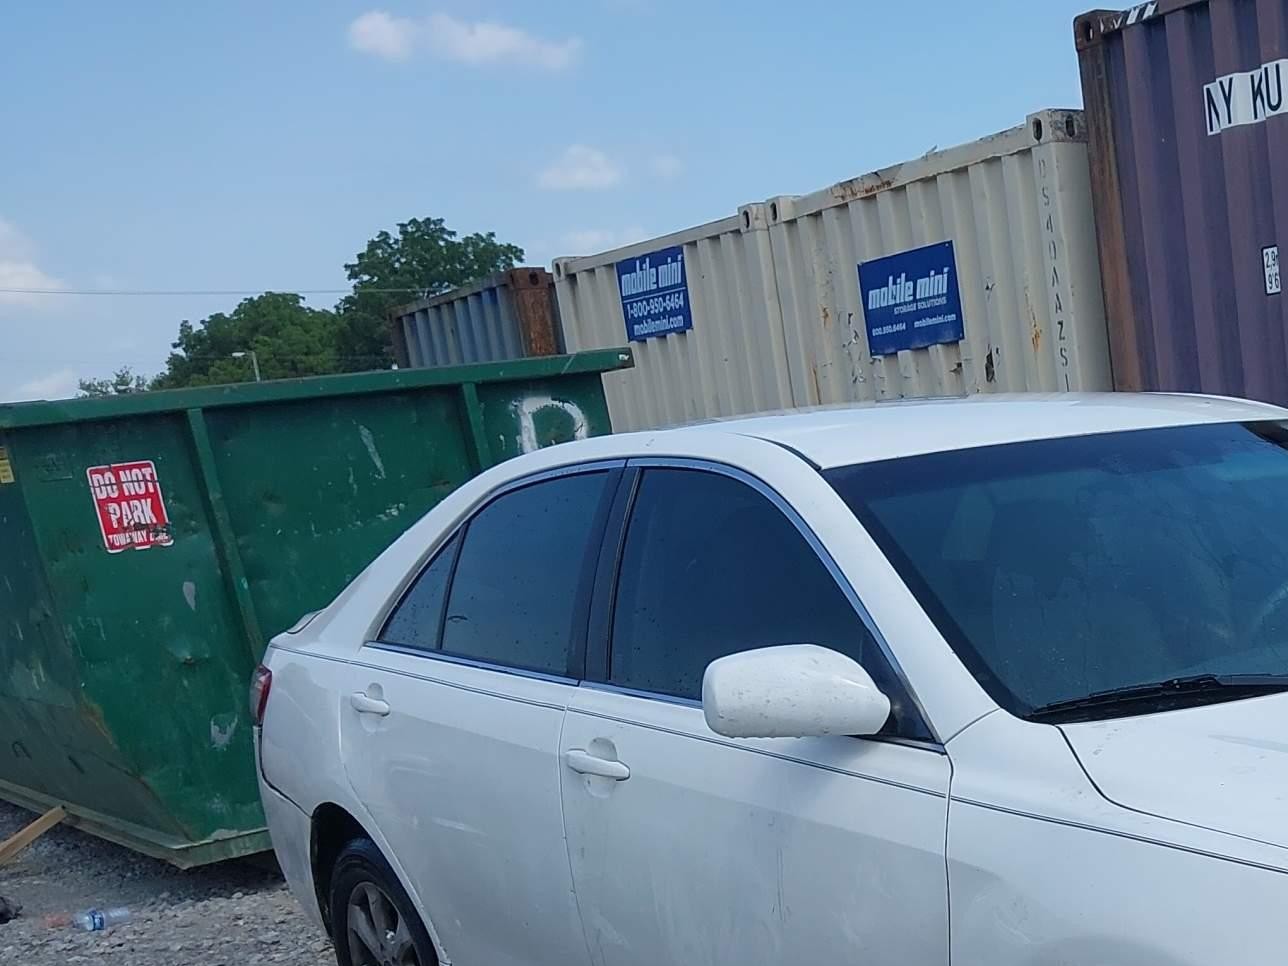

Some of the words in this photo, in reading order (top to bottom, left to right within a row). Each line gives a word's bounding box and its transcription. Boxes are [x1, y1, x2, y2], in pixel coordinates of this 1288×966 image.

[1250, 63, 1282, 120] KU
[622, 257, 658, 297] mobile
[658, 254, 683, 288] mini
[868, 272, 914, 310] mobile
[916, 267, 950, 299] mini
[627, 291, 684, 319] 1-800-950-6464
[633, 315, 684, 336] mobilemini.com
[91, 471, 119, 500] DO
[119, 467, 155, 497] NOT
[106, 498, 158, 529] PARK
